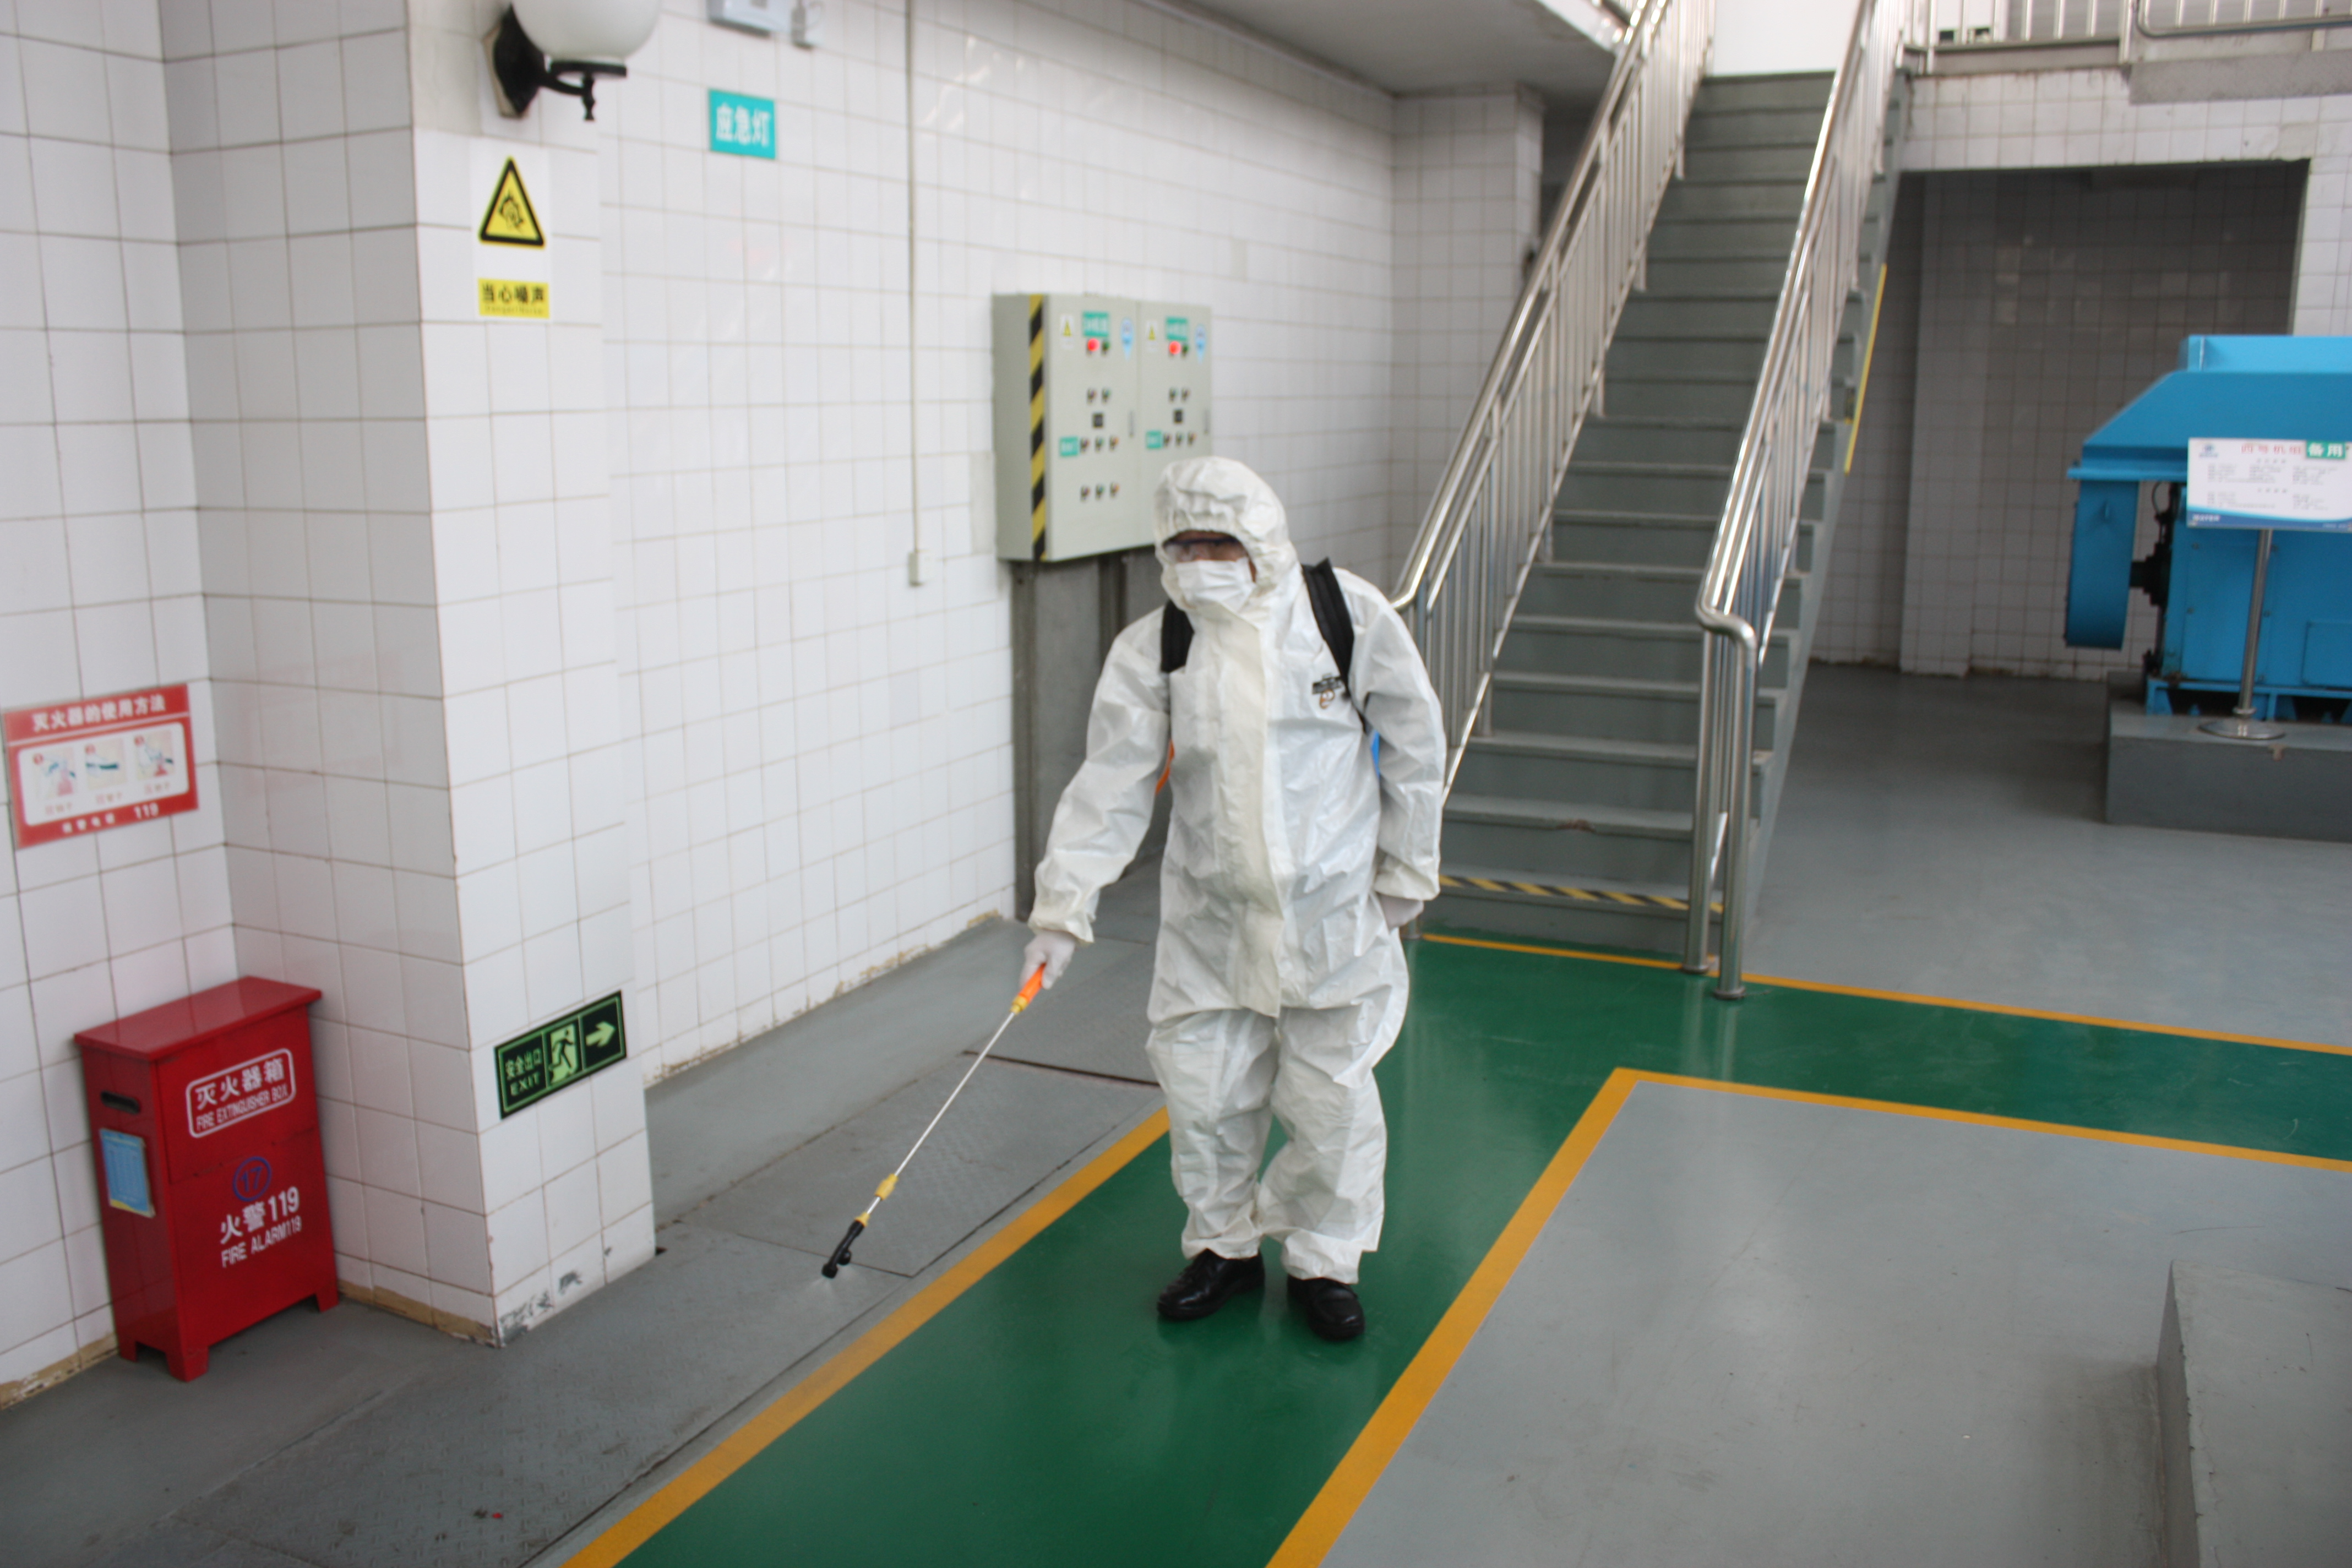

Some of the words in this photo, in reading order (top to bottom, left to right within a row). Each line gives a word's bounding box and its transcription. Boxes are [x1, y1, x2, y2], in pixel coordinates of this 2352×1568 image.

[715, 101, 771, 148] 应急灯
[482, 283, 545, 304] 当心噪声
[2307, 443, 2343, 458] 备用
[33, 694, 165, 733] 灭火器的使用方法
[505, 1048, 543, 1081] 安全出口
[195, 1058, 285, 1110] 灭火器箱
[510, 1071, 540, 1096] EXIT
[196, 1111, 215, 1131] FIRE
[240, 1166, 263, 1193] 17
[221, 1241, 248, 1268] FIRE
